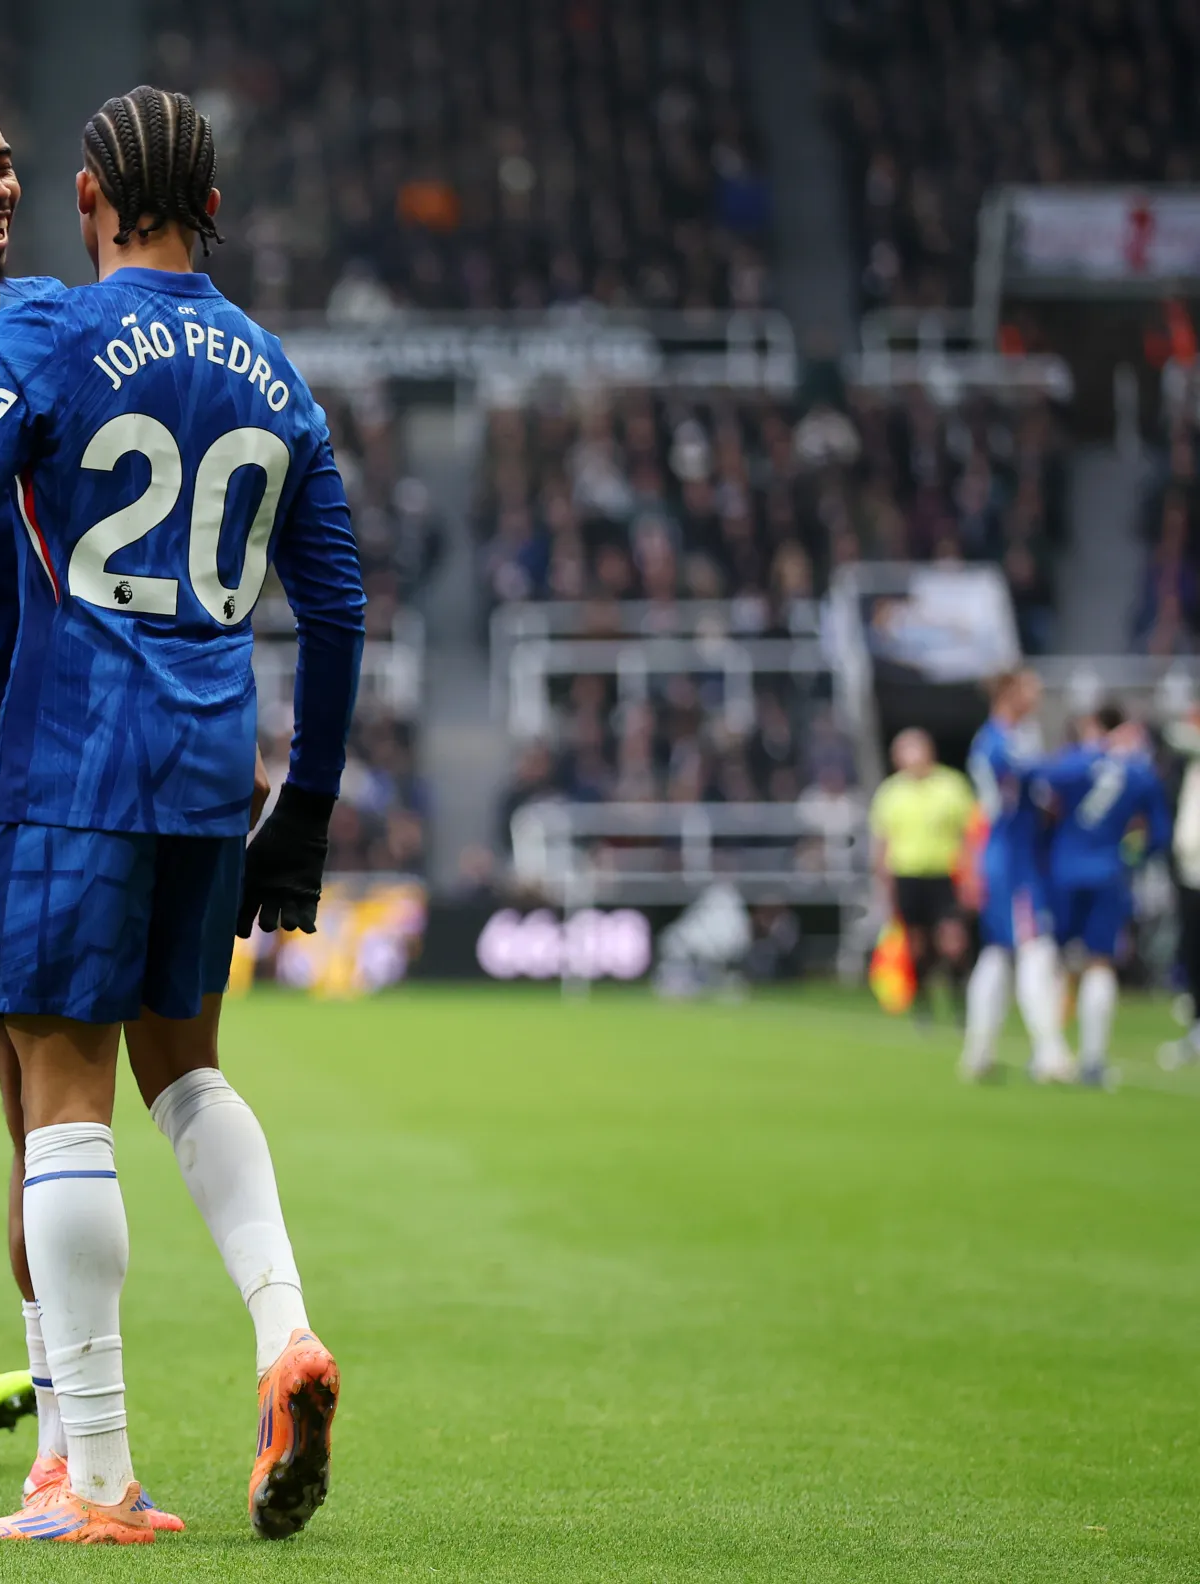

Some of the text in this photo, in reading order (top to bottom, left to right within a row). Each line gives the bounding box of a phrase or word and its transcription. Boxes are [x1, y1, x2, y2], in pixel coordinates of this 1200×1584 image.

[93, 313, 175, 391] JOÃO
[184, 321, 290, 412] PEDRO
[68, 412, 291, 626] 20
